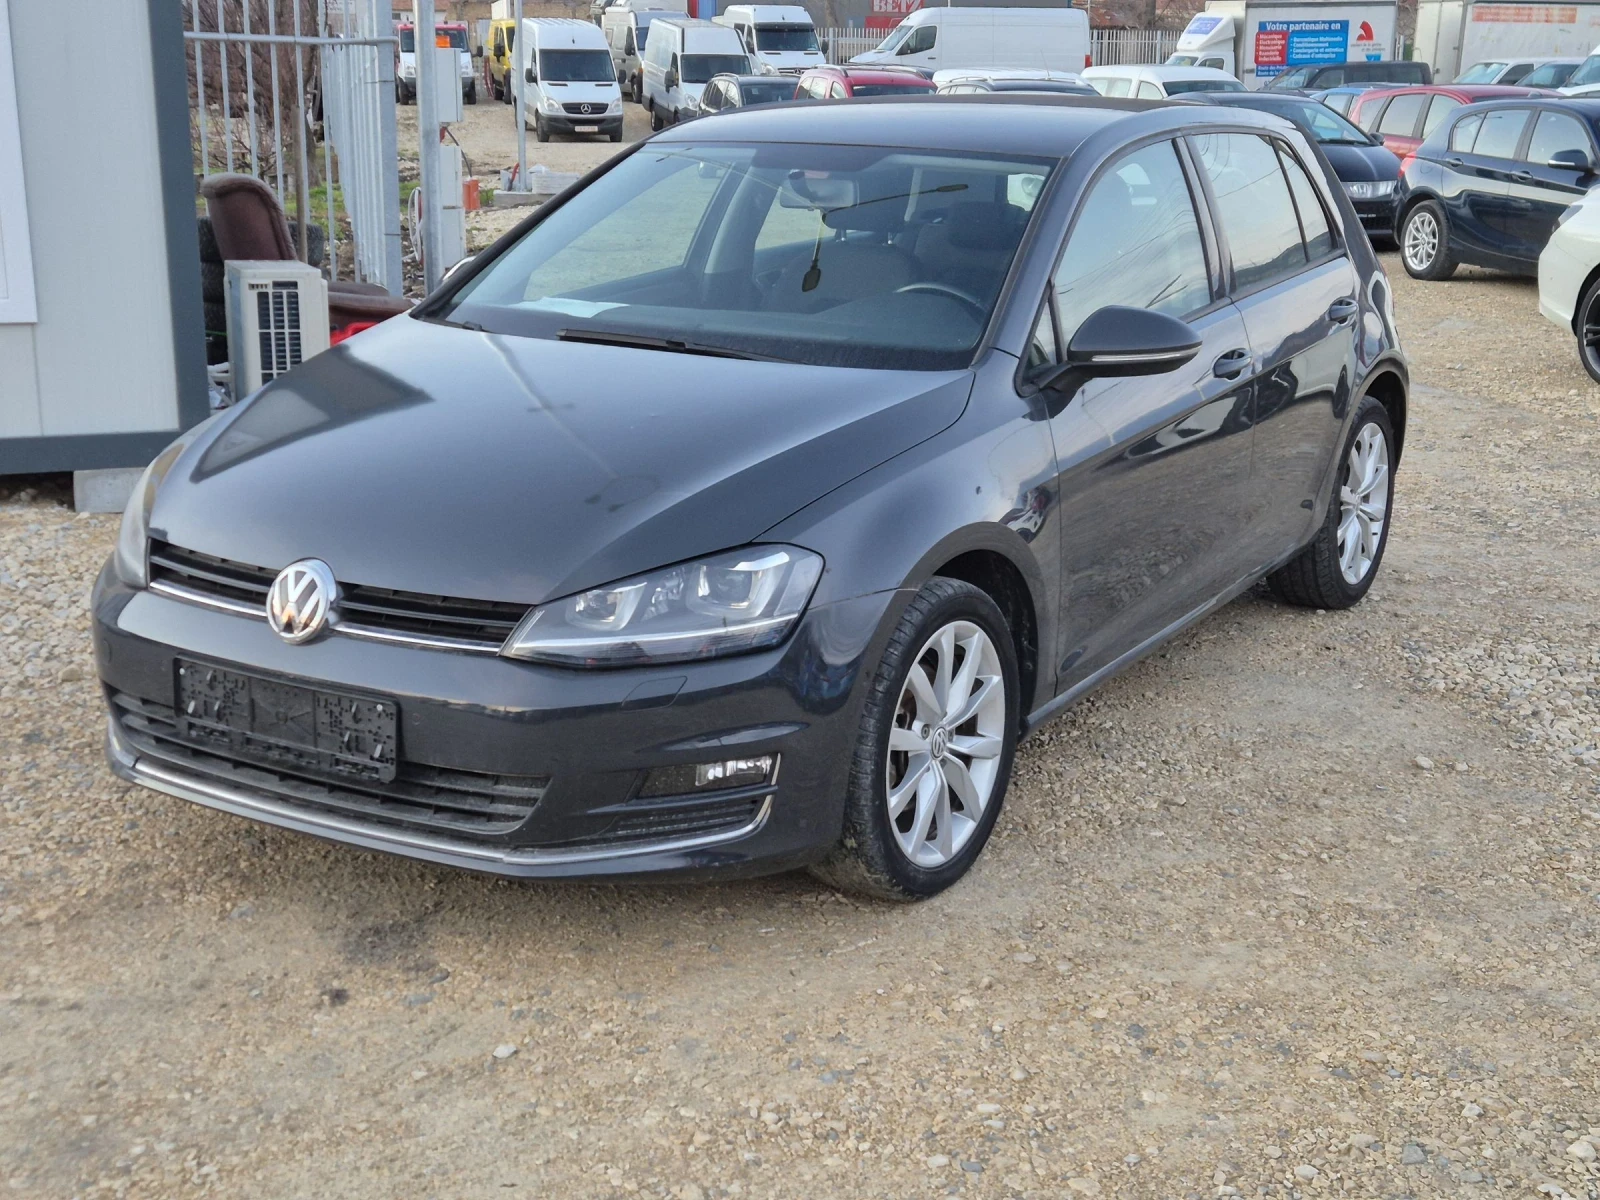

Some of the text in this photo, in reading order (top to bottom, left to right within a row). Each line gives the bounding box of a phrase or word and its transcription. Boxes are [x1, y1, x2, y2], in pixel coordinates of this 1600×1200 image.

[1266, 22, 1288, 31] Votre
[1289, 21, 1329, 32] partenaire
[269, 564, 328, 639] VW
